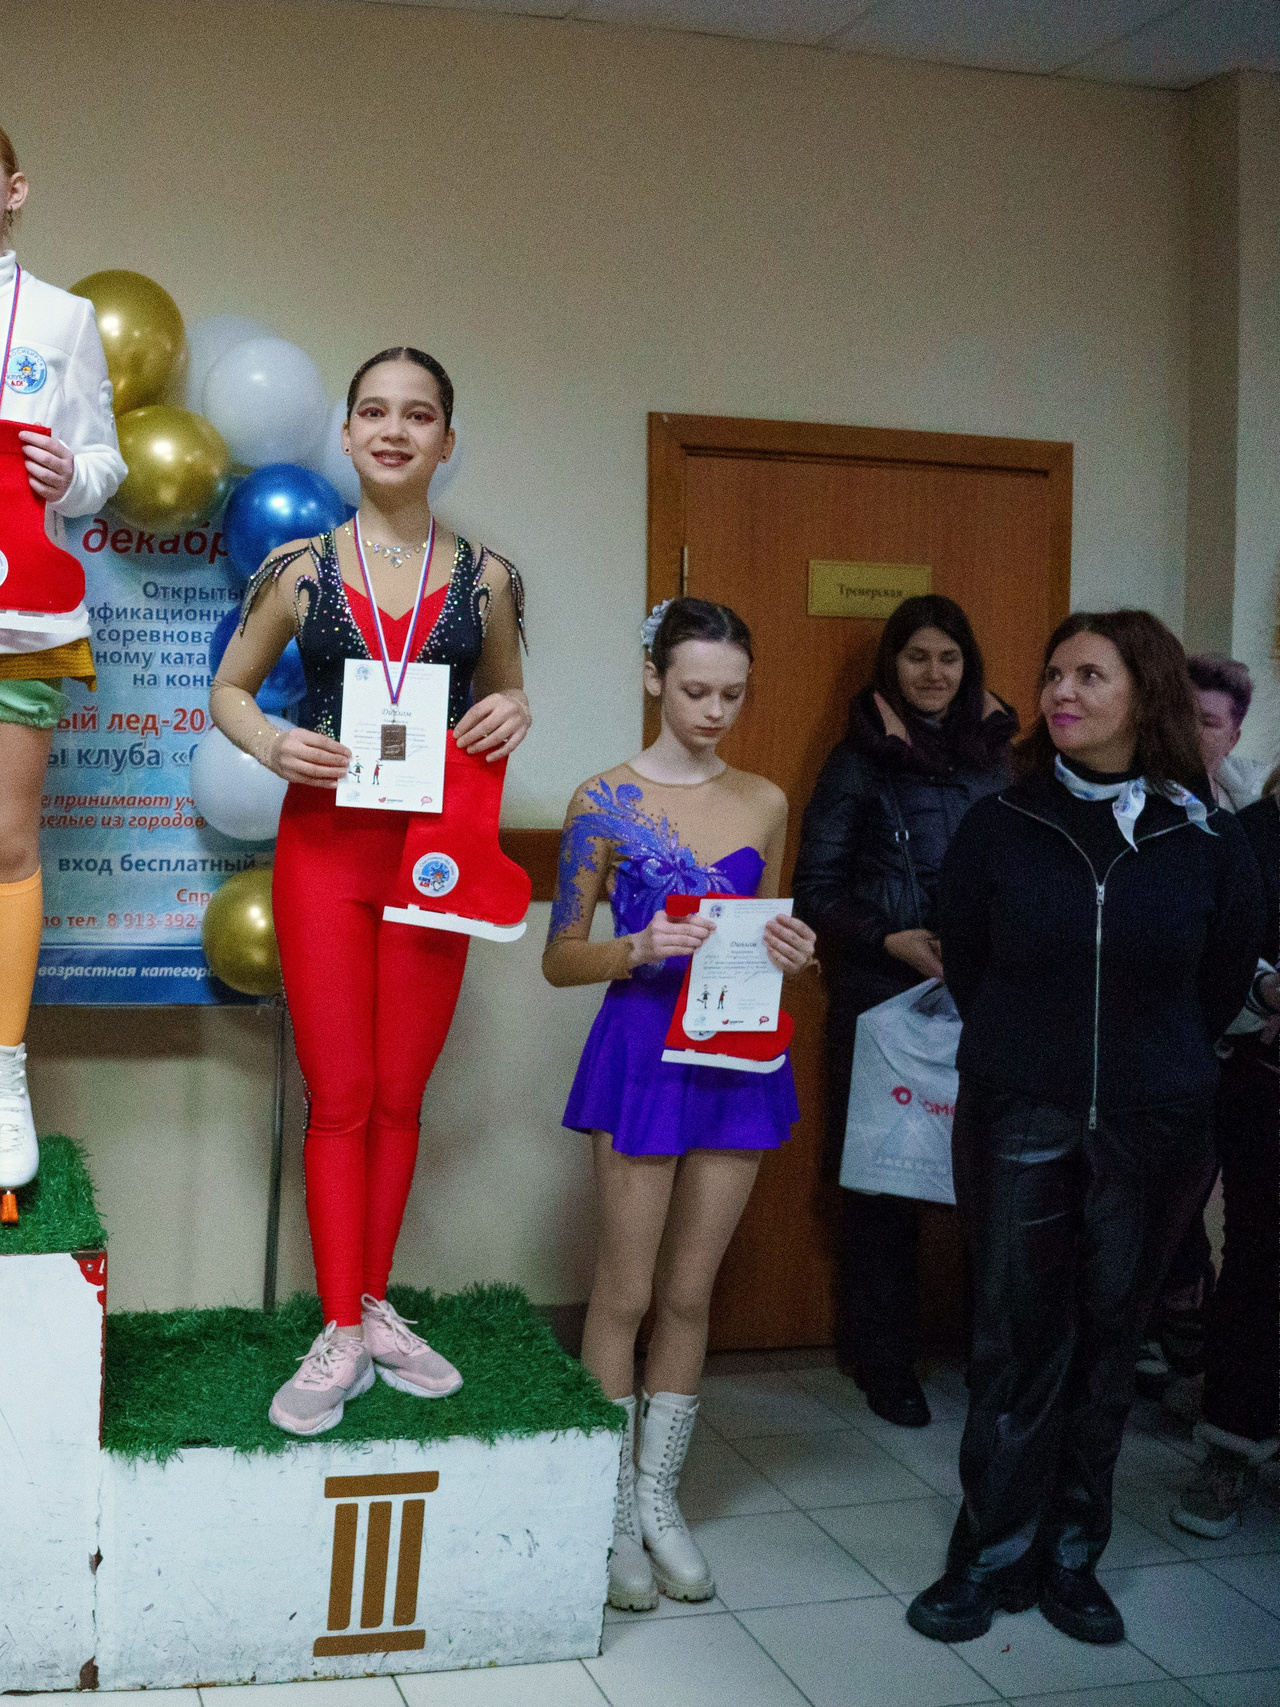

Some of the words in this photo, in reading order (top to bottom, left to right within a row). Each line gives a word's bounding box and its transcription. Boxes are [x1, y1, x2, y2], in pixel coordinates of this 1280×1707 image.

[88, 602, 230, 625] ификационн
[133, 674, 157, 687] на
[106, 708, 215, 736] лед-20
[77, 743, 161, 773] клуба
[54, 793, 170, 811] принимают
[101, 815, 122, 827] из
[128, 812, 206, 830] городов
[58, 858, 113, 876] вход
[120, 853, 256, 873] бесплатный
[107, 912, 117, 927] 8
[38, 966, 136, 979] возрастная
